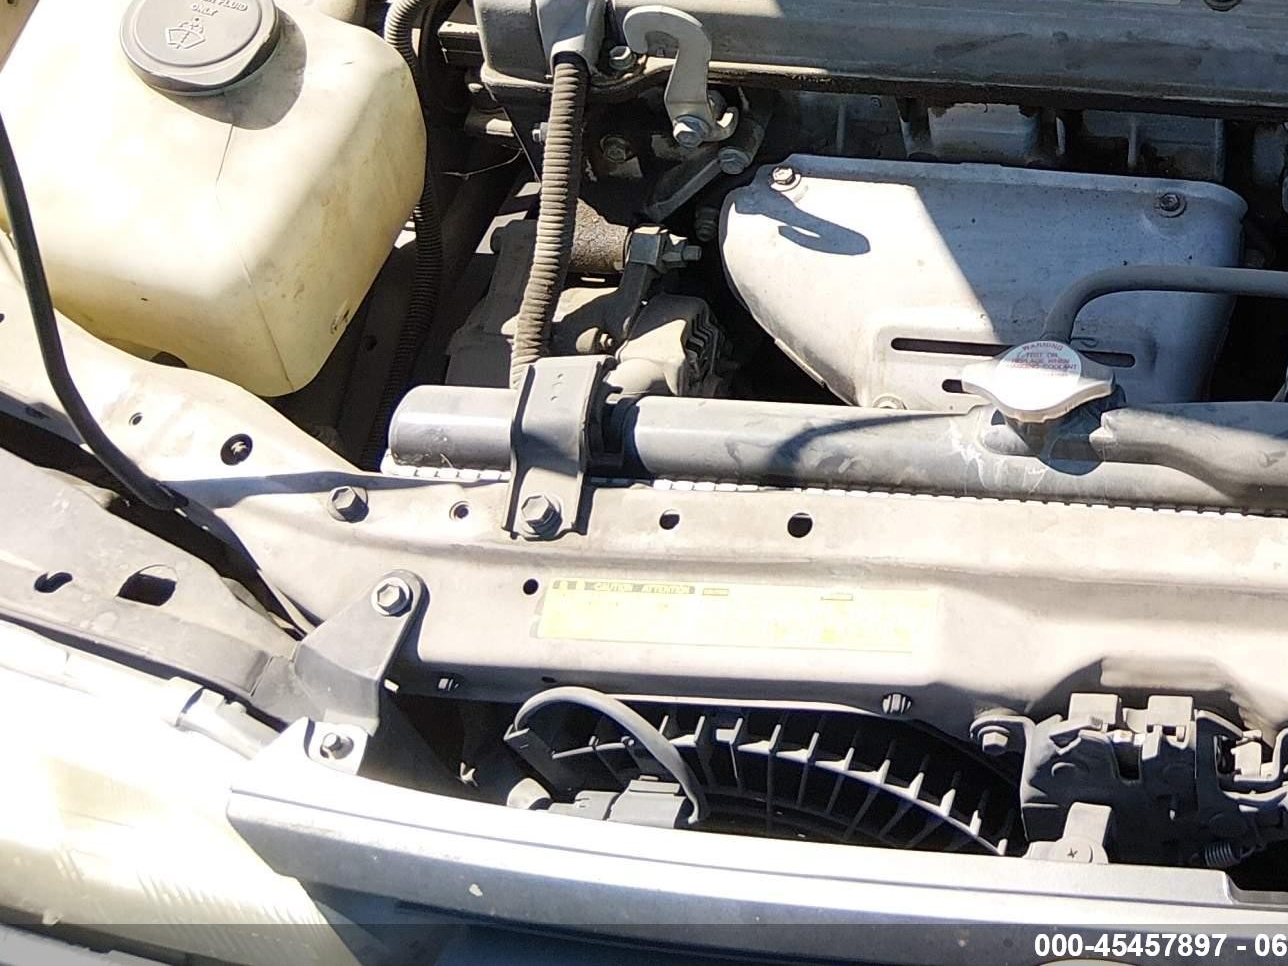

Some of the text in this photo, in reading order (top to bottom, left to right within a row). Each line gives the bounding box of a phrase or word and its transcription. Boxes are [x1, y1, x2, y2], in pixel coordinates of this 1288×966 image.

[190, 3, 219, 17] ONLY
[218, 0, 249, 12] FLUID
[1022, 342, 1063, 351] WARNING
